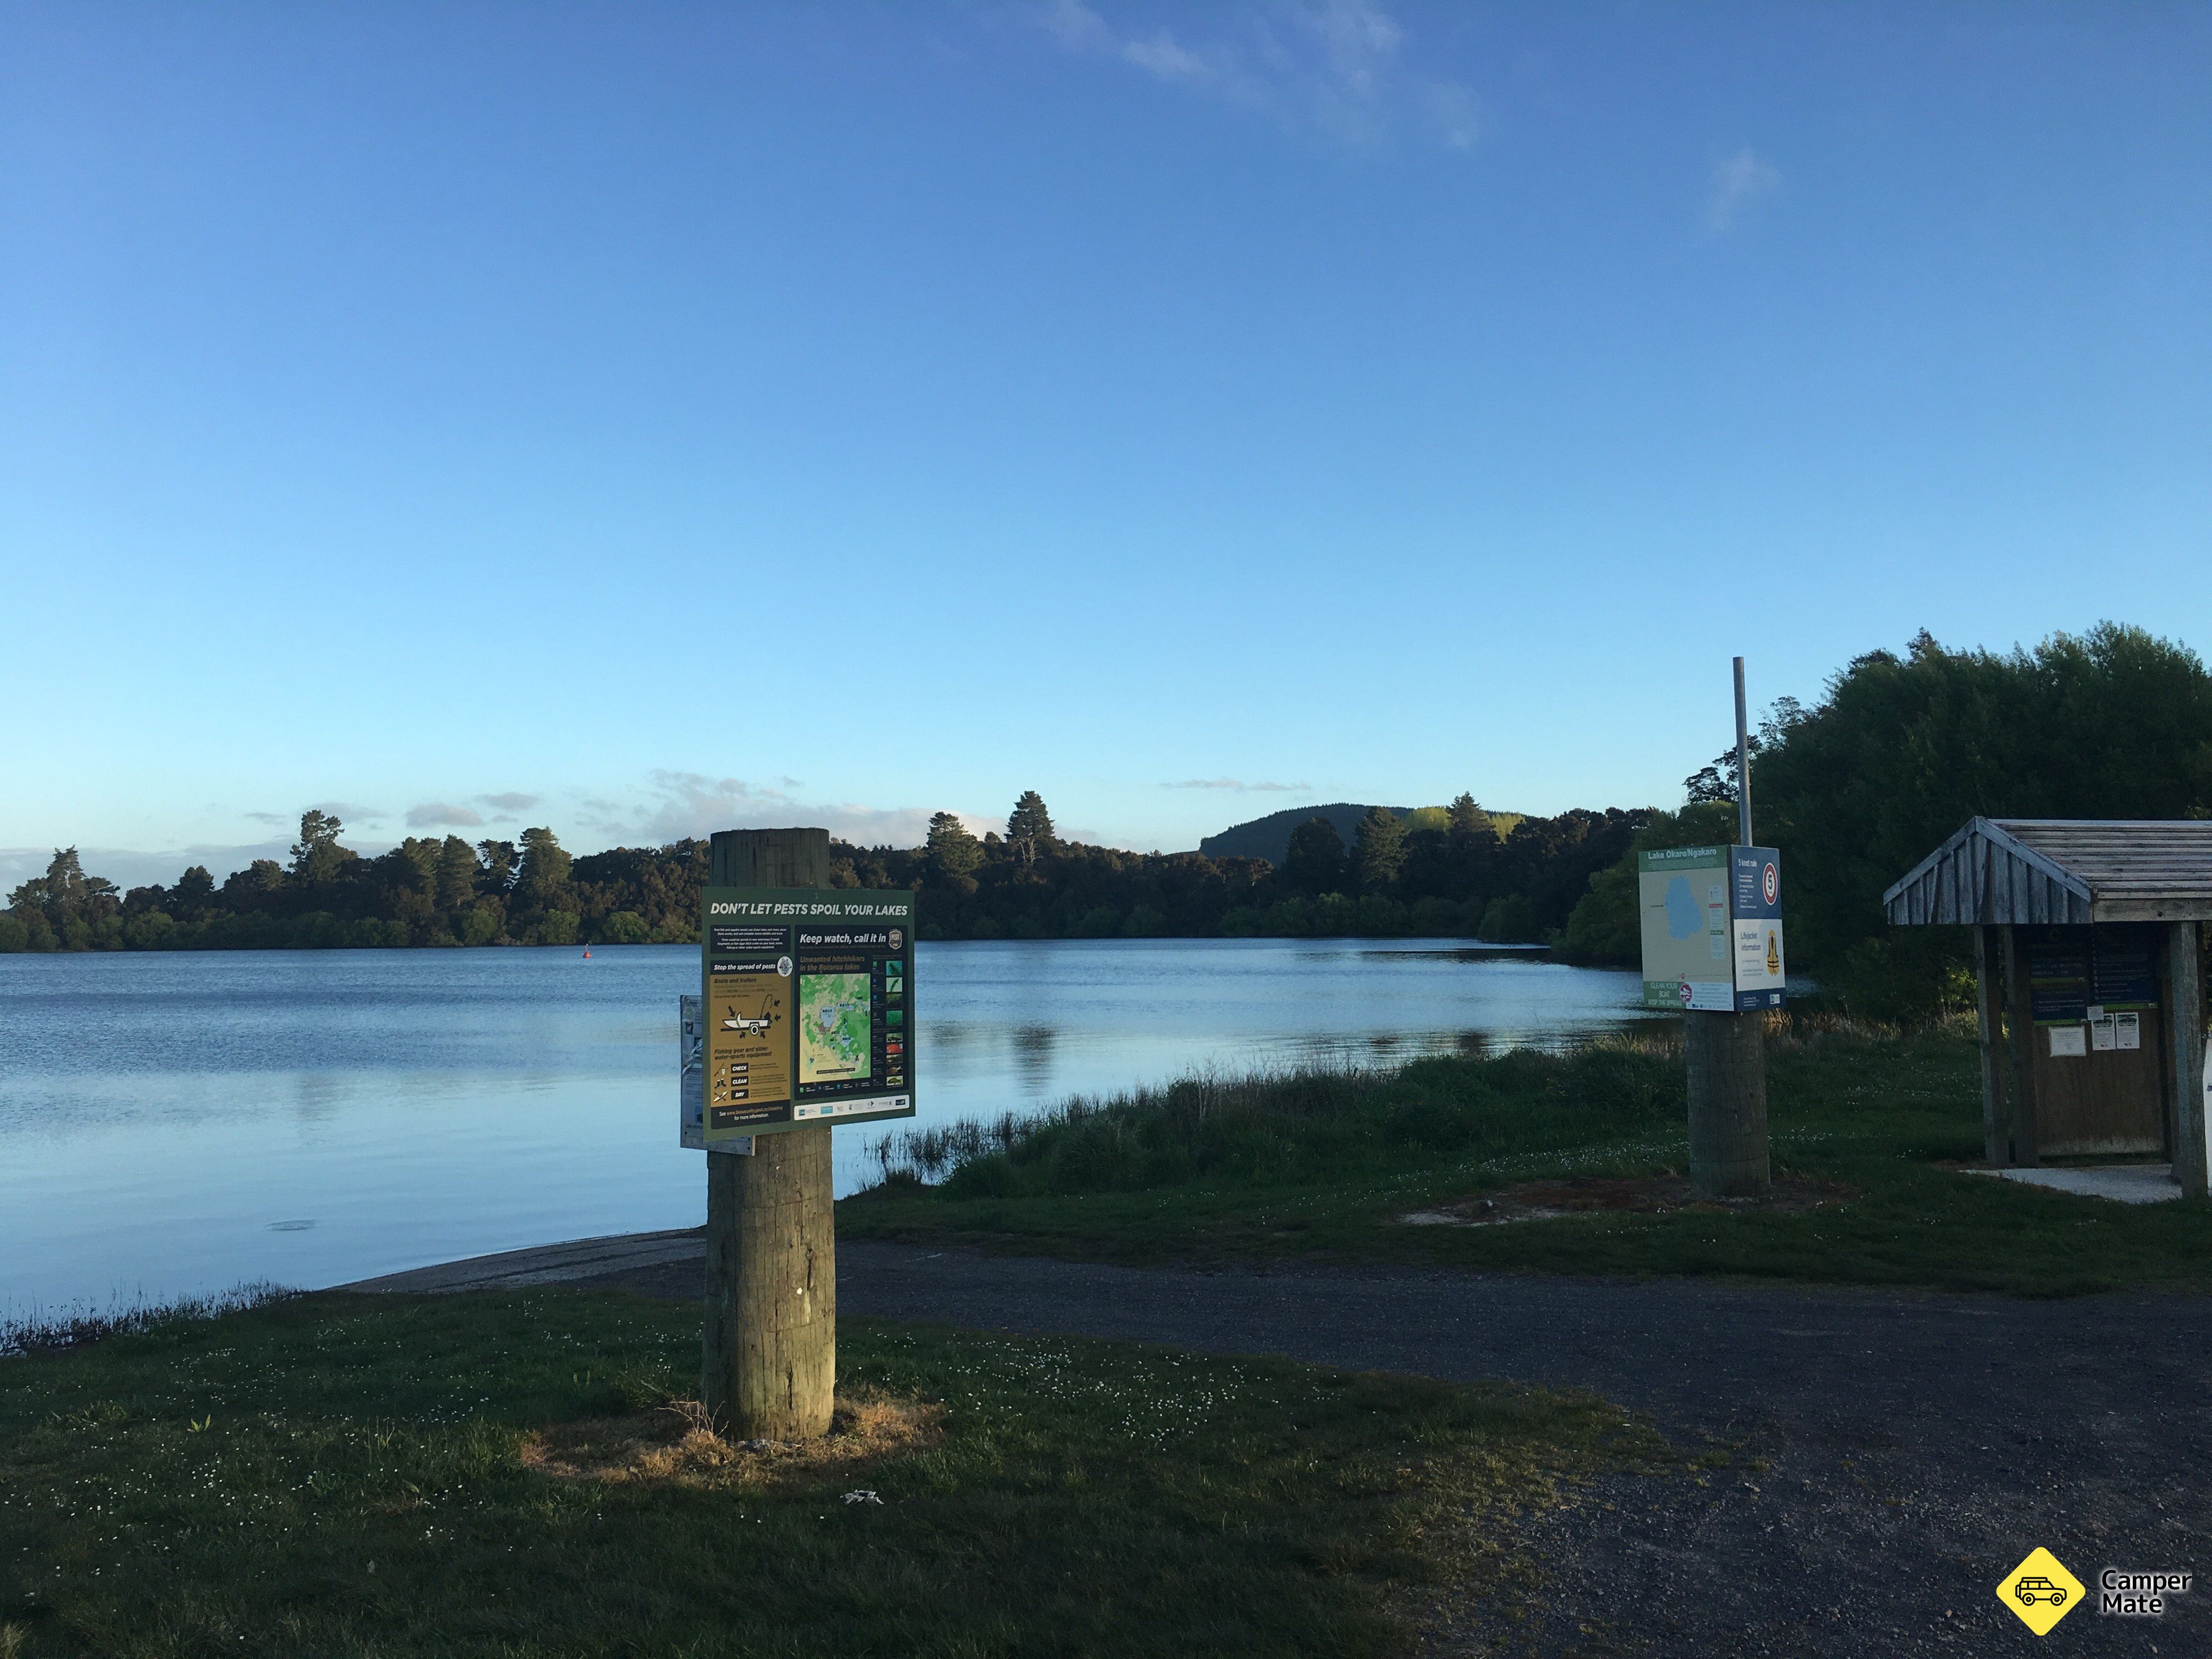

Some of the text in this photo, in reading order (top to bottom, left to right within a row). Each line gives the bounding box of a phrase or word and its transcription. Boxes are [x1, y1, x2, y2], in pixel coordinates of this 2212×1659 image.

[1738, 858, 1741, 867] 5
[1768, 874, 1773, 890] 5
[711, 903, 908, 915] DON'T LET PESTS SPOIL YOUR LAKES
[800, 933, 886, 945] Keep watch, call it in
